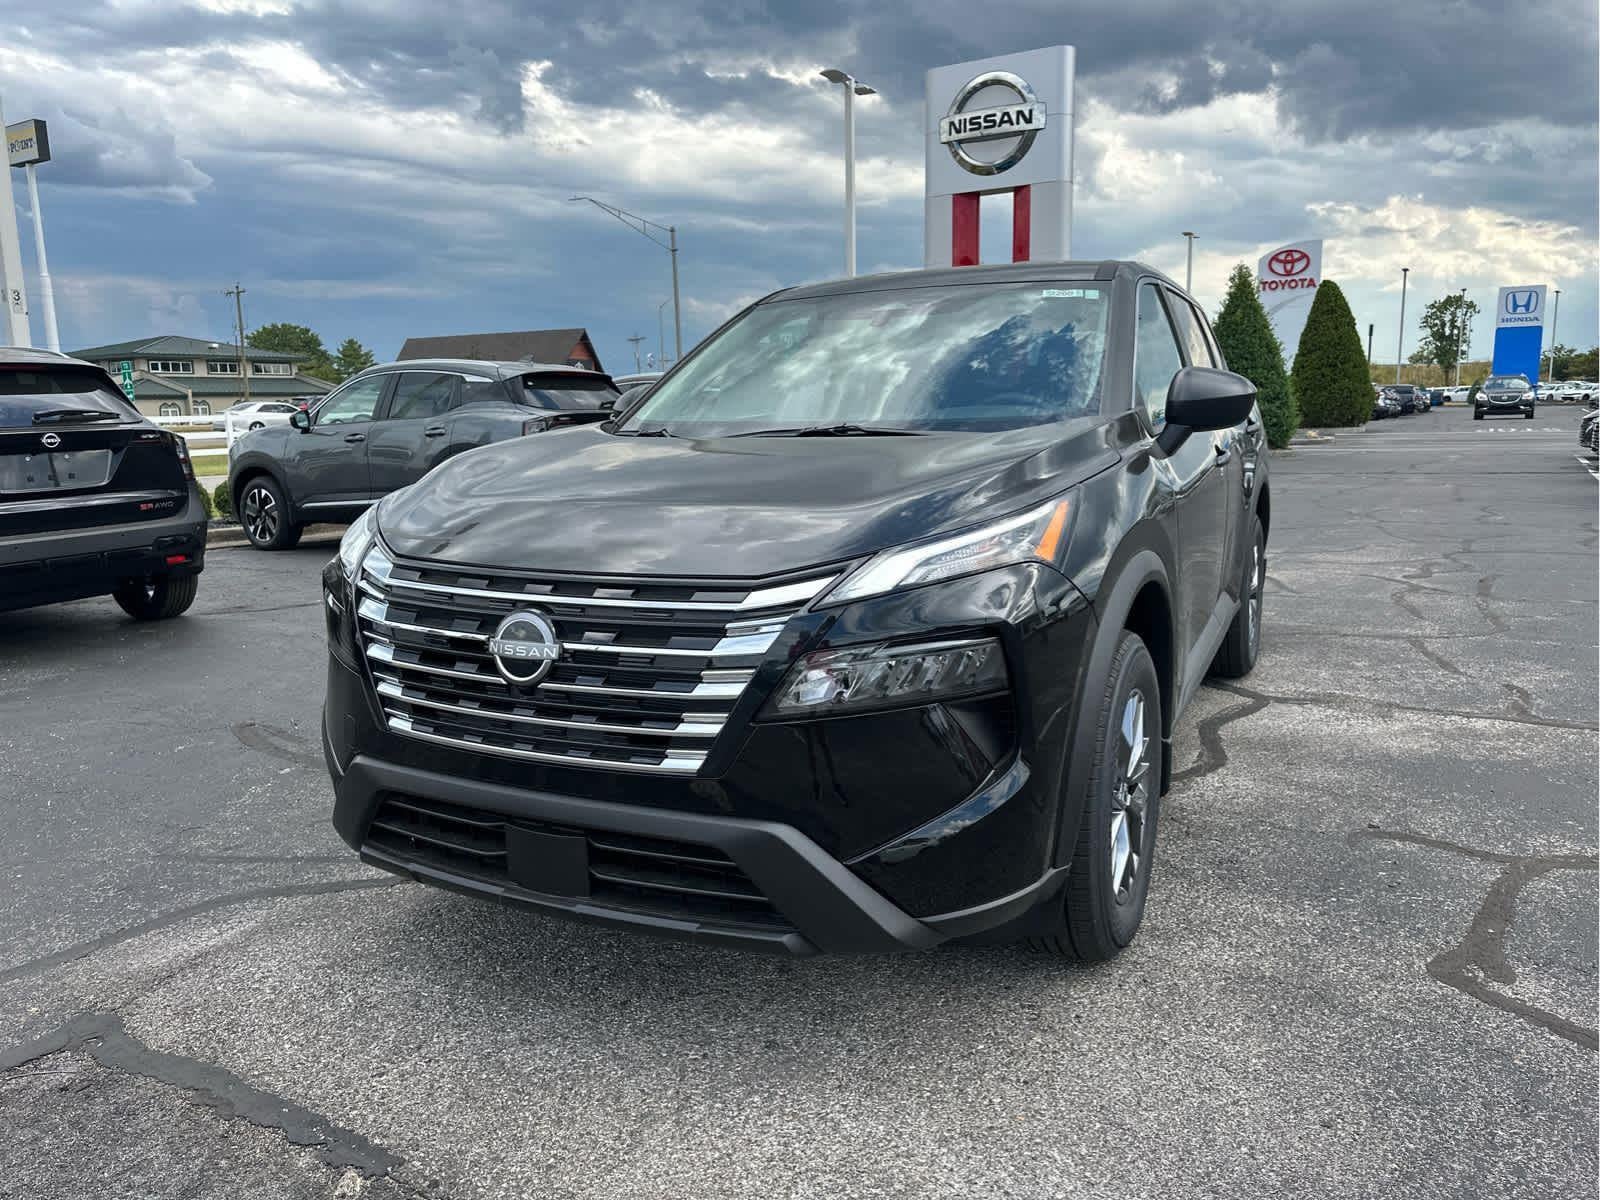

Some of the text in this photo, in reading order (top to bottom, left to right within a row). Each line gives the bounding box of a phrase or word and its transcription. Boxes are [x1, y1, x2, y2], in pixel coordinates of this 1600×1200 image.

[948, 108, 1033, 137] NISSAN
[1260, 278, 1317, 291] TOYOTA
[13, 290, 21, 301] 3
[489, 640, 557, 658] NISSAN
